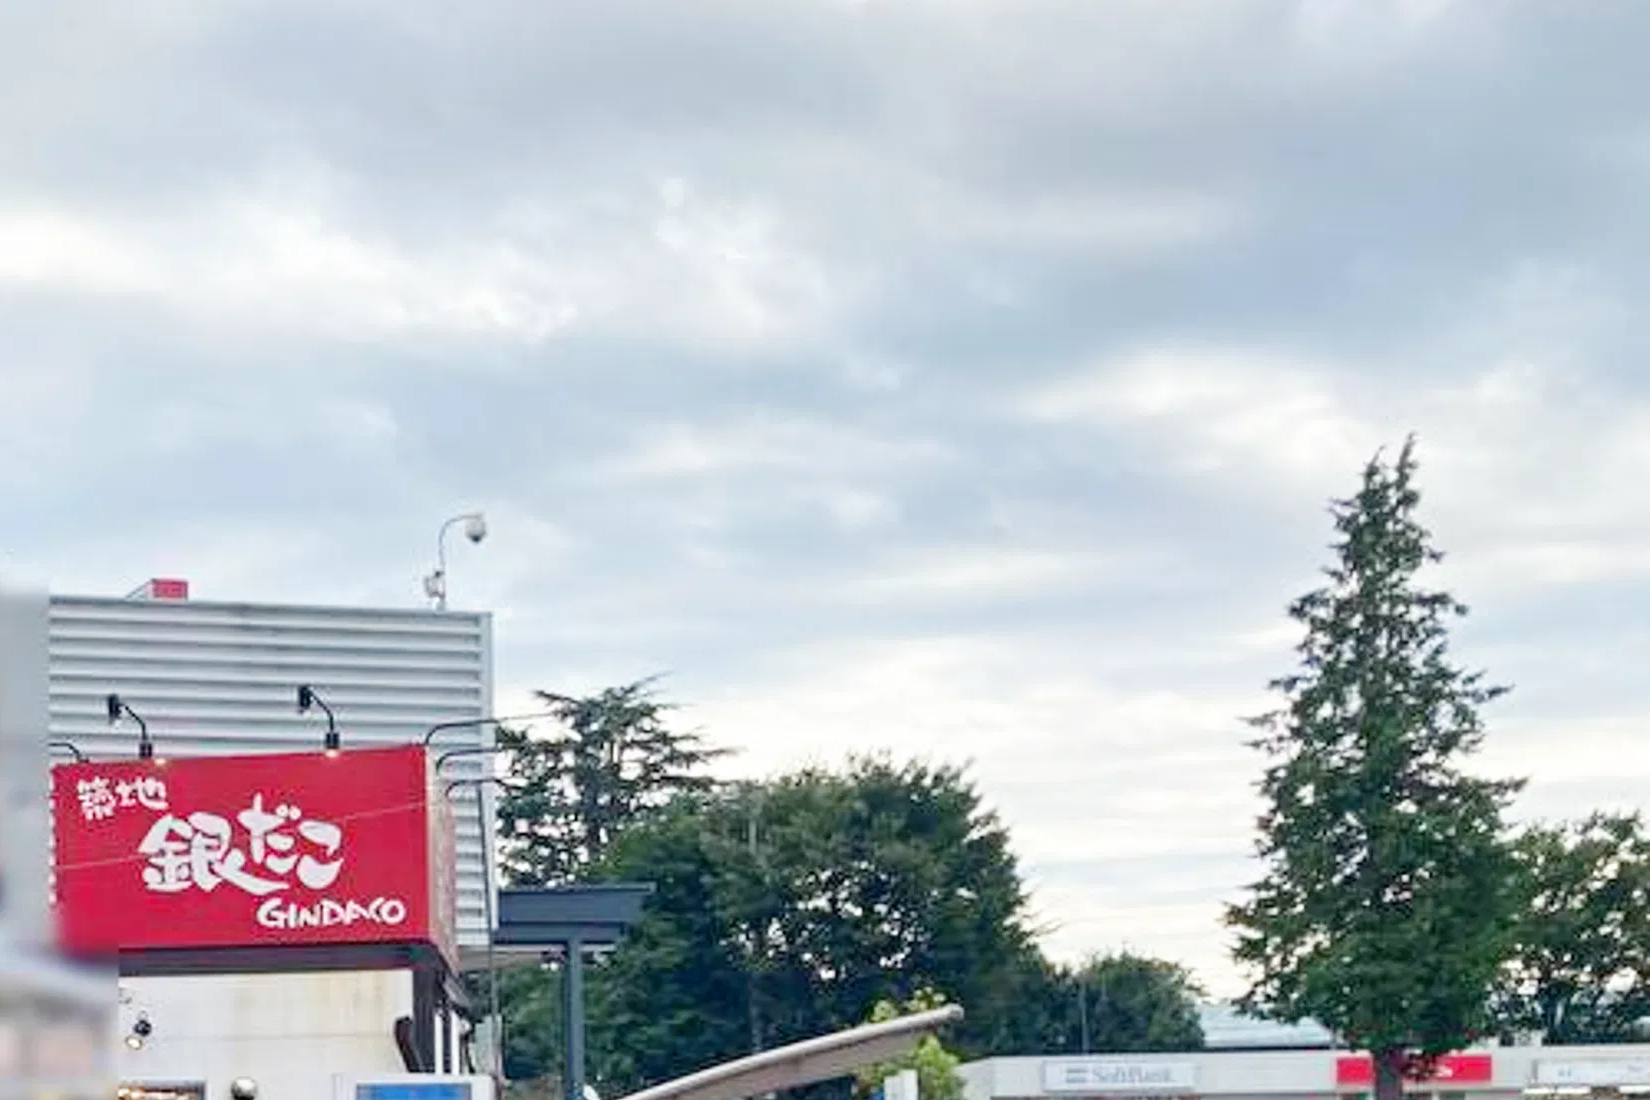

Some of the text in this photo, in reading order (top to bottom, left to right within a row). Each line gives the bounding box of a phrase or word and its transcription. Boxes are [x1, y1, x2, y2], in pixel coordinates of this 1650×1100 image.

[77, 776, 168, 820] 築地
[137, 793, 344, 895] 銀だこ
[256, 896, 408, 929] GINDACO
